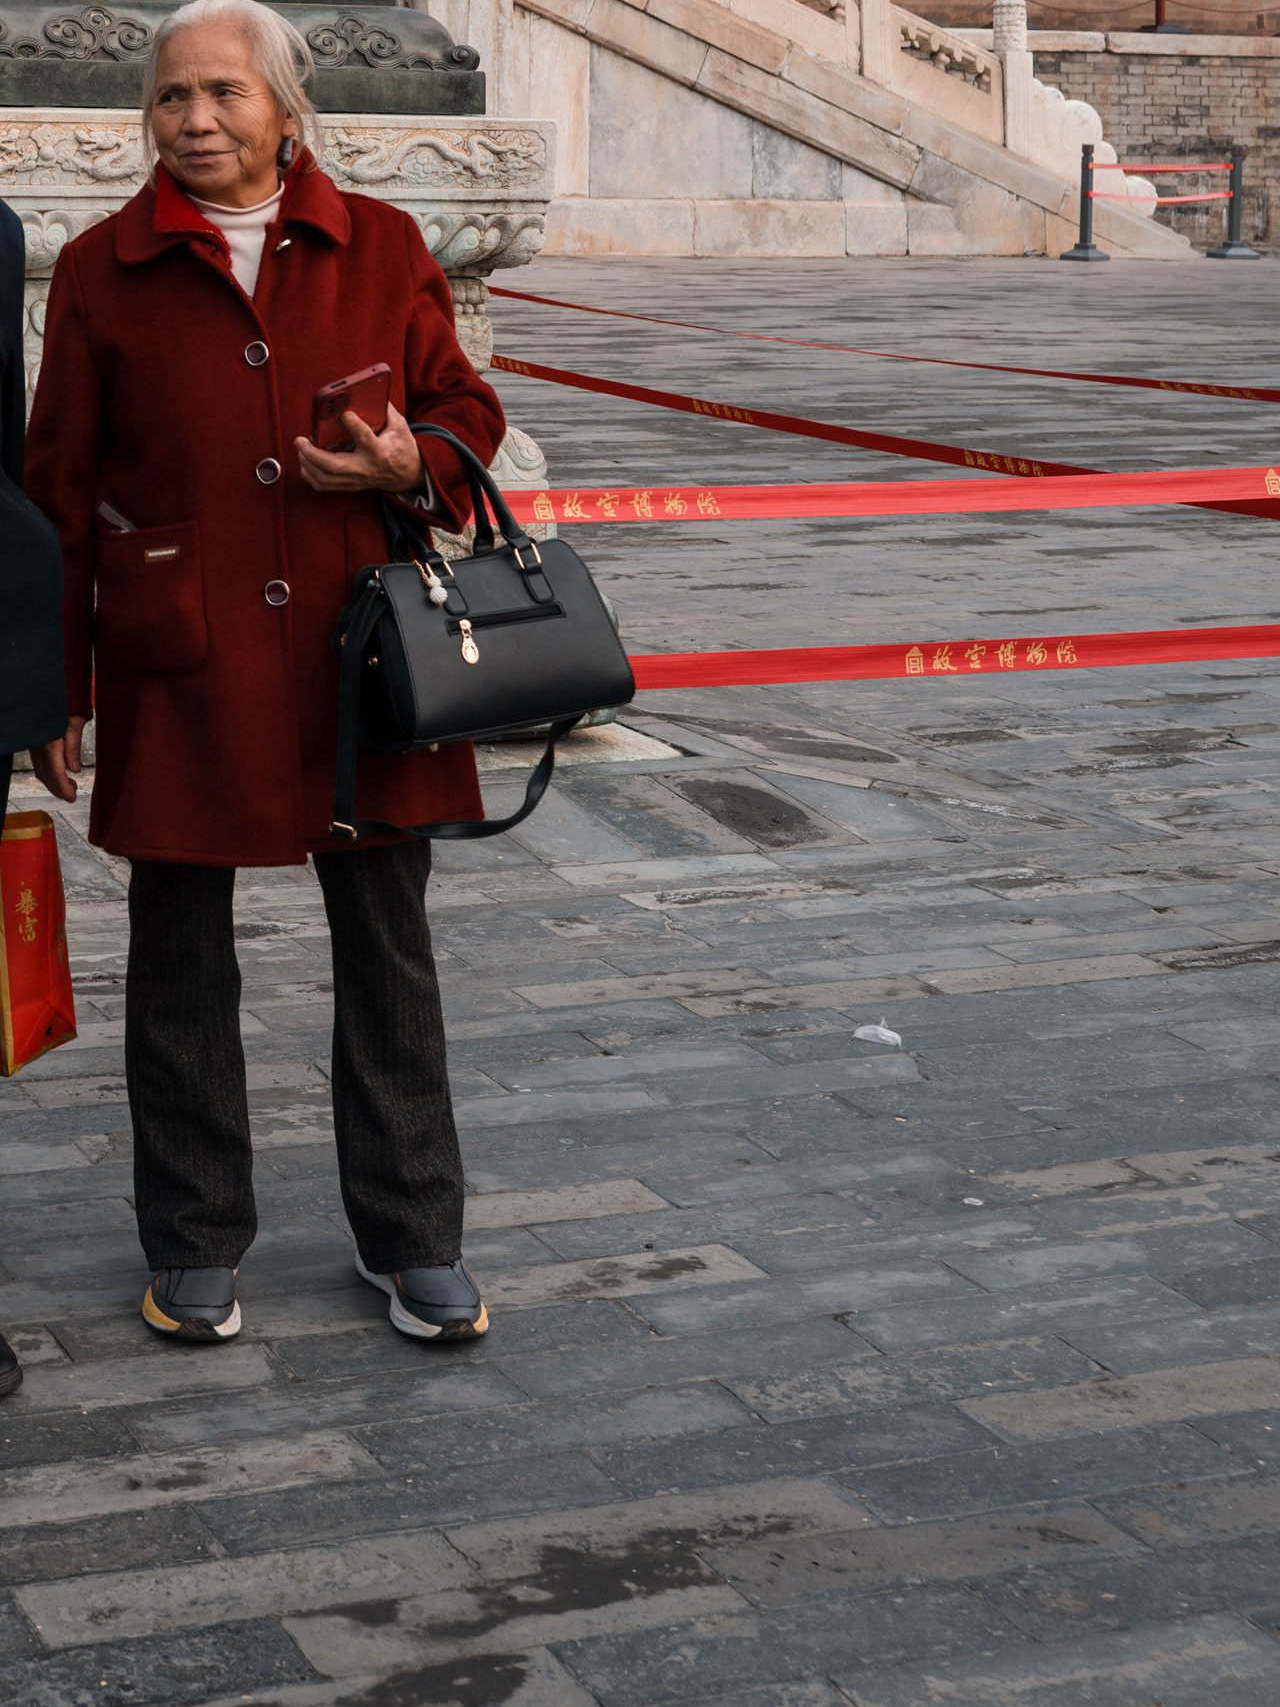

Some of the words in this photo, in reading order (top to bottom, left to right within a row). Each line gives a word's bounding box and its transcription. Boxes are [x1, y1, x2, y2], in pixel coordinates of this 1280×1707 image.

[562, 491, 722, 519] 故宫博物院
[932, 640, 1078, 671] 故宫博物院
[15, 888, 38, 944] 暴富
